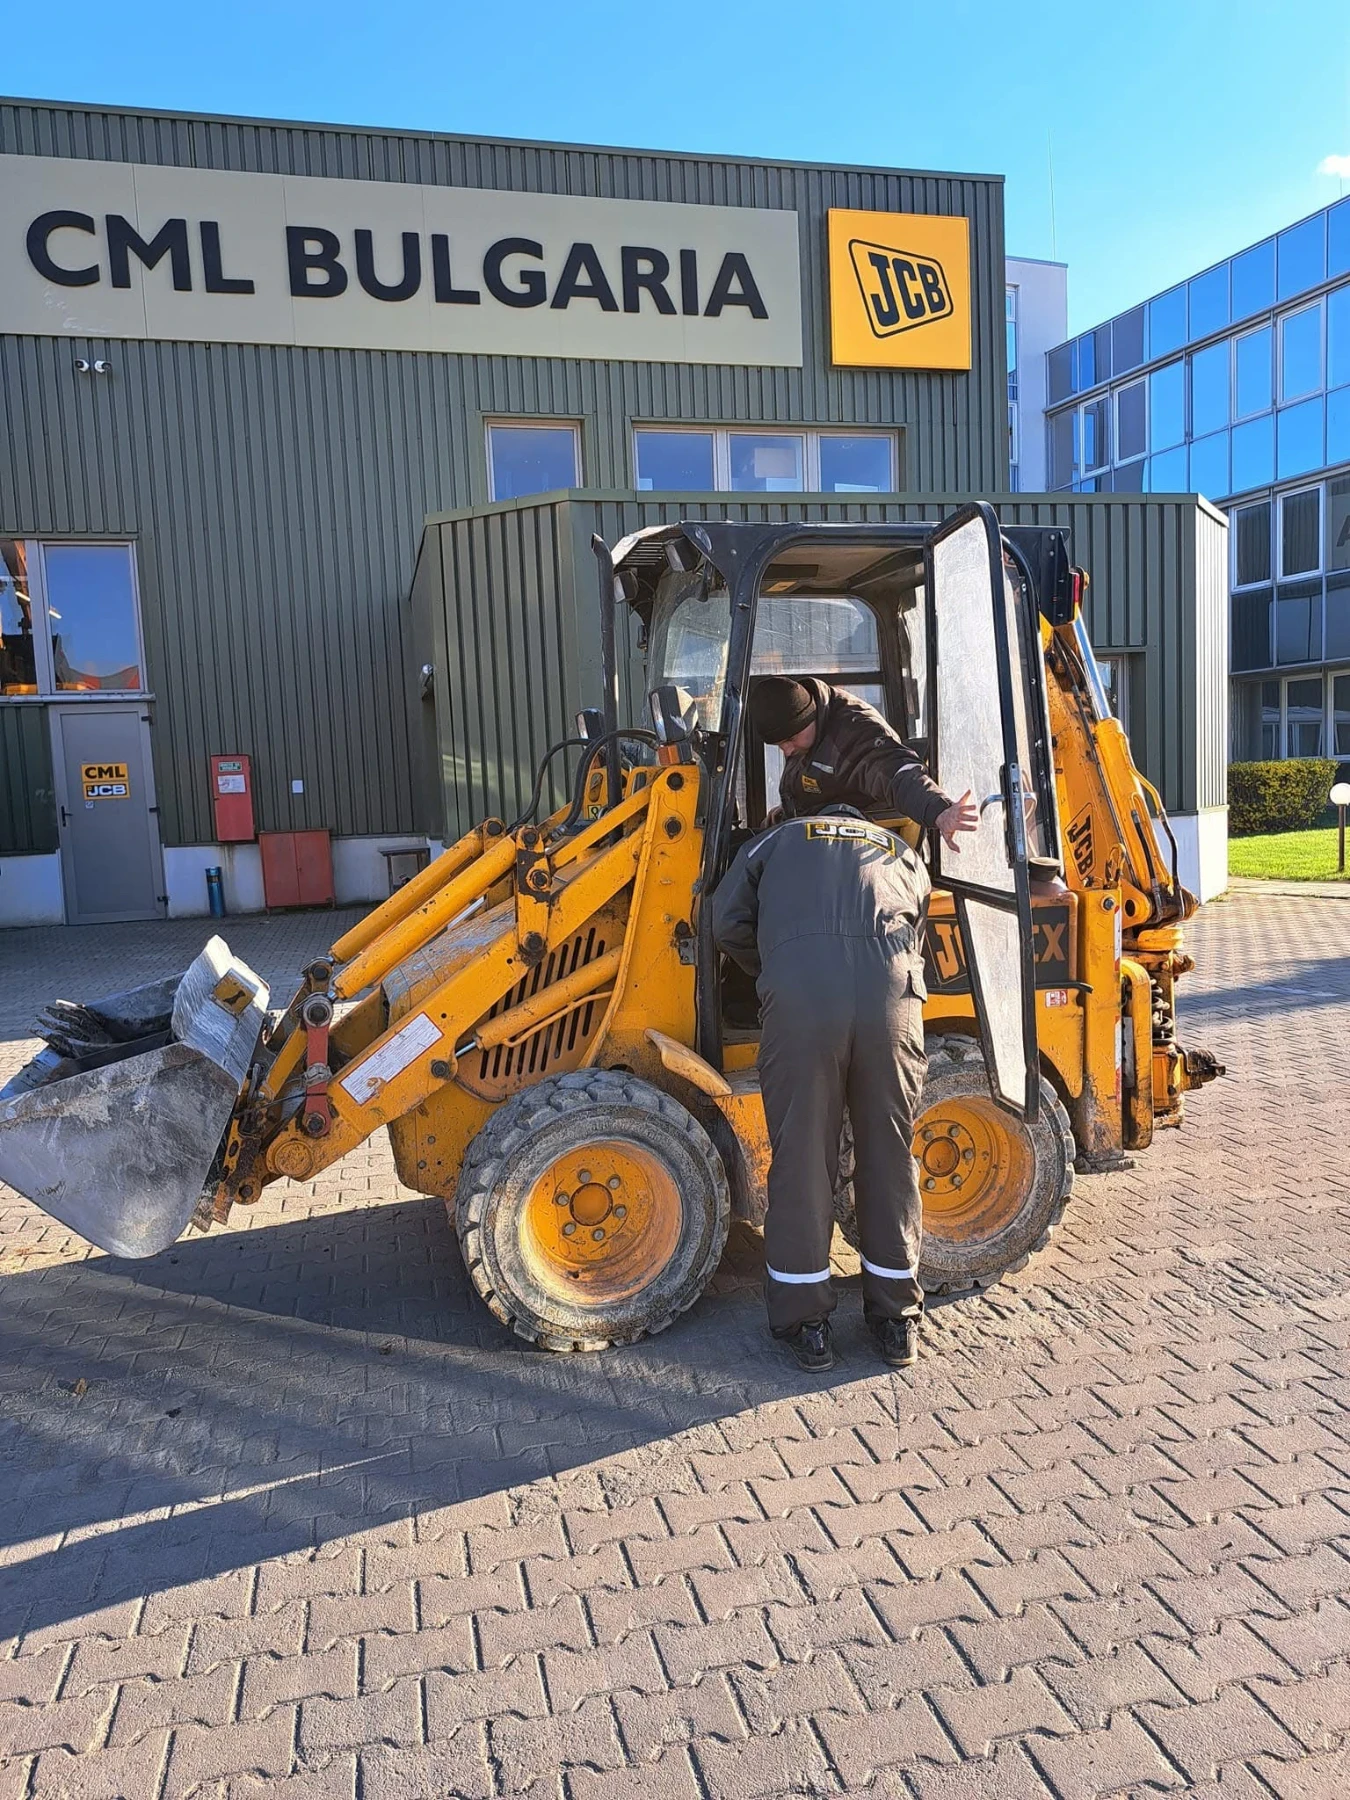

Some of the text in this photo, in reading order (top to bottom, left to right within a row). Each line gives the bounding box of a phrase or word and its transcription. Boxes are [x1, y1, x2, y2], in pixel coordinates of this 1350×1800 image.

[26, 210, 769, 319] CML BULGARIA
[867, 251, 946, 327] JCB
[84, 766, 126, 779] CML
[87, 784, 126, 797] JCB
[815, 822, 889, 848] JCB
[1067, 814, 1094, 876] JCB
